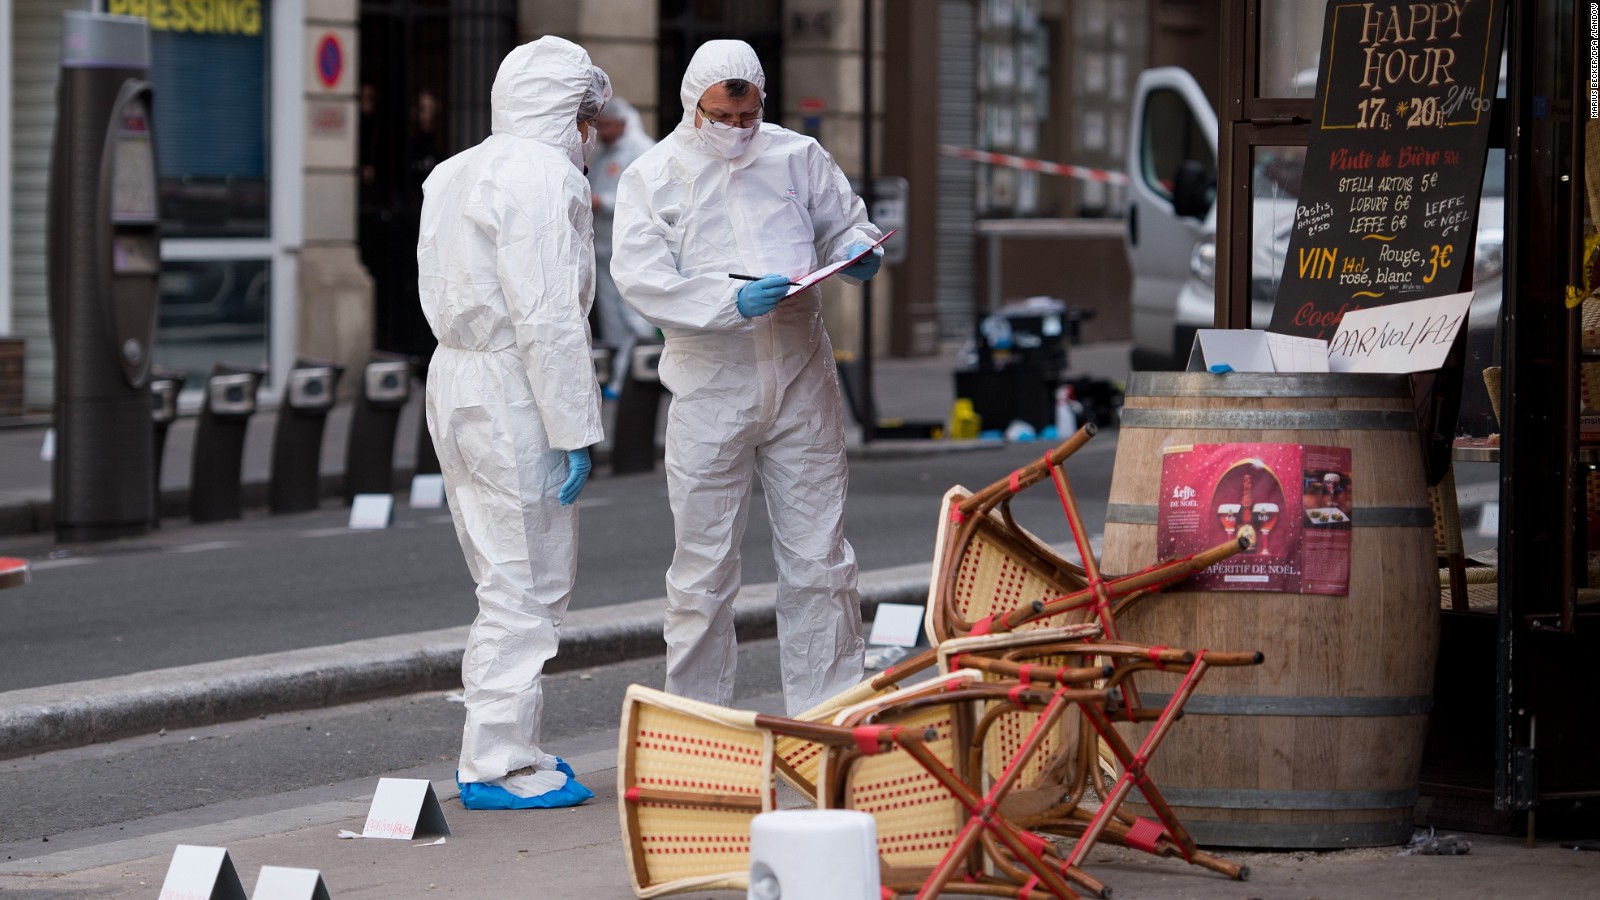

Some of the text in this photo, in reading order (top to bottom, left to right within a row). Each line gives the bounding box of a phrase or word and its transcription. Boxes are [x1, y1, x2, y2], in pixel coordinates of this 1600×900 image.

[1359, 0, 1470, 47] HAPPY
[1359, 47, 1456, 92] HOUR
[1329, 147, 1372, 171] Pinte
[1377, 151, 1392, 168] de
[1397, 145, 1440, 168] Bière
[1339, 172, 1439, 193] STELLA ARTOIS 5€
[1296, 201, 1331, 220] Pastis
[1349, 195, 1412, 213] LOBURG 6€
[1425, 195, 1465, 217] LEFFE
[1349, 215, 1408, 234] LEFFE 6€
[1423, 219, 1437, 228] DE
[1299, 244, 1453, 283] VIN 14cl Rouge, 3€
[1339, 266, 1413, 287] rosé, blanc
[1172, 485, 1196, 500] Leffe
[1180, 499, 1199, 508] NOËL
[1200, 563, 1296, 575] APÉRITIF DE NOËL
